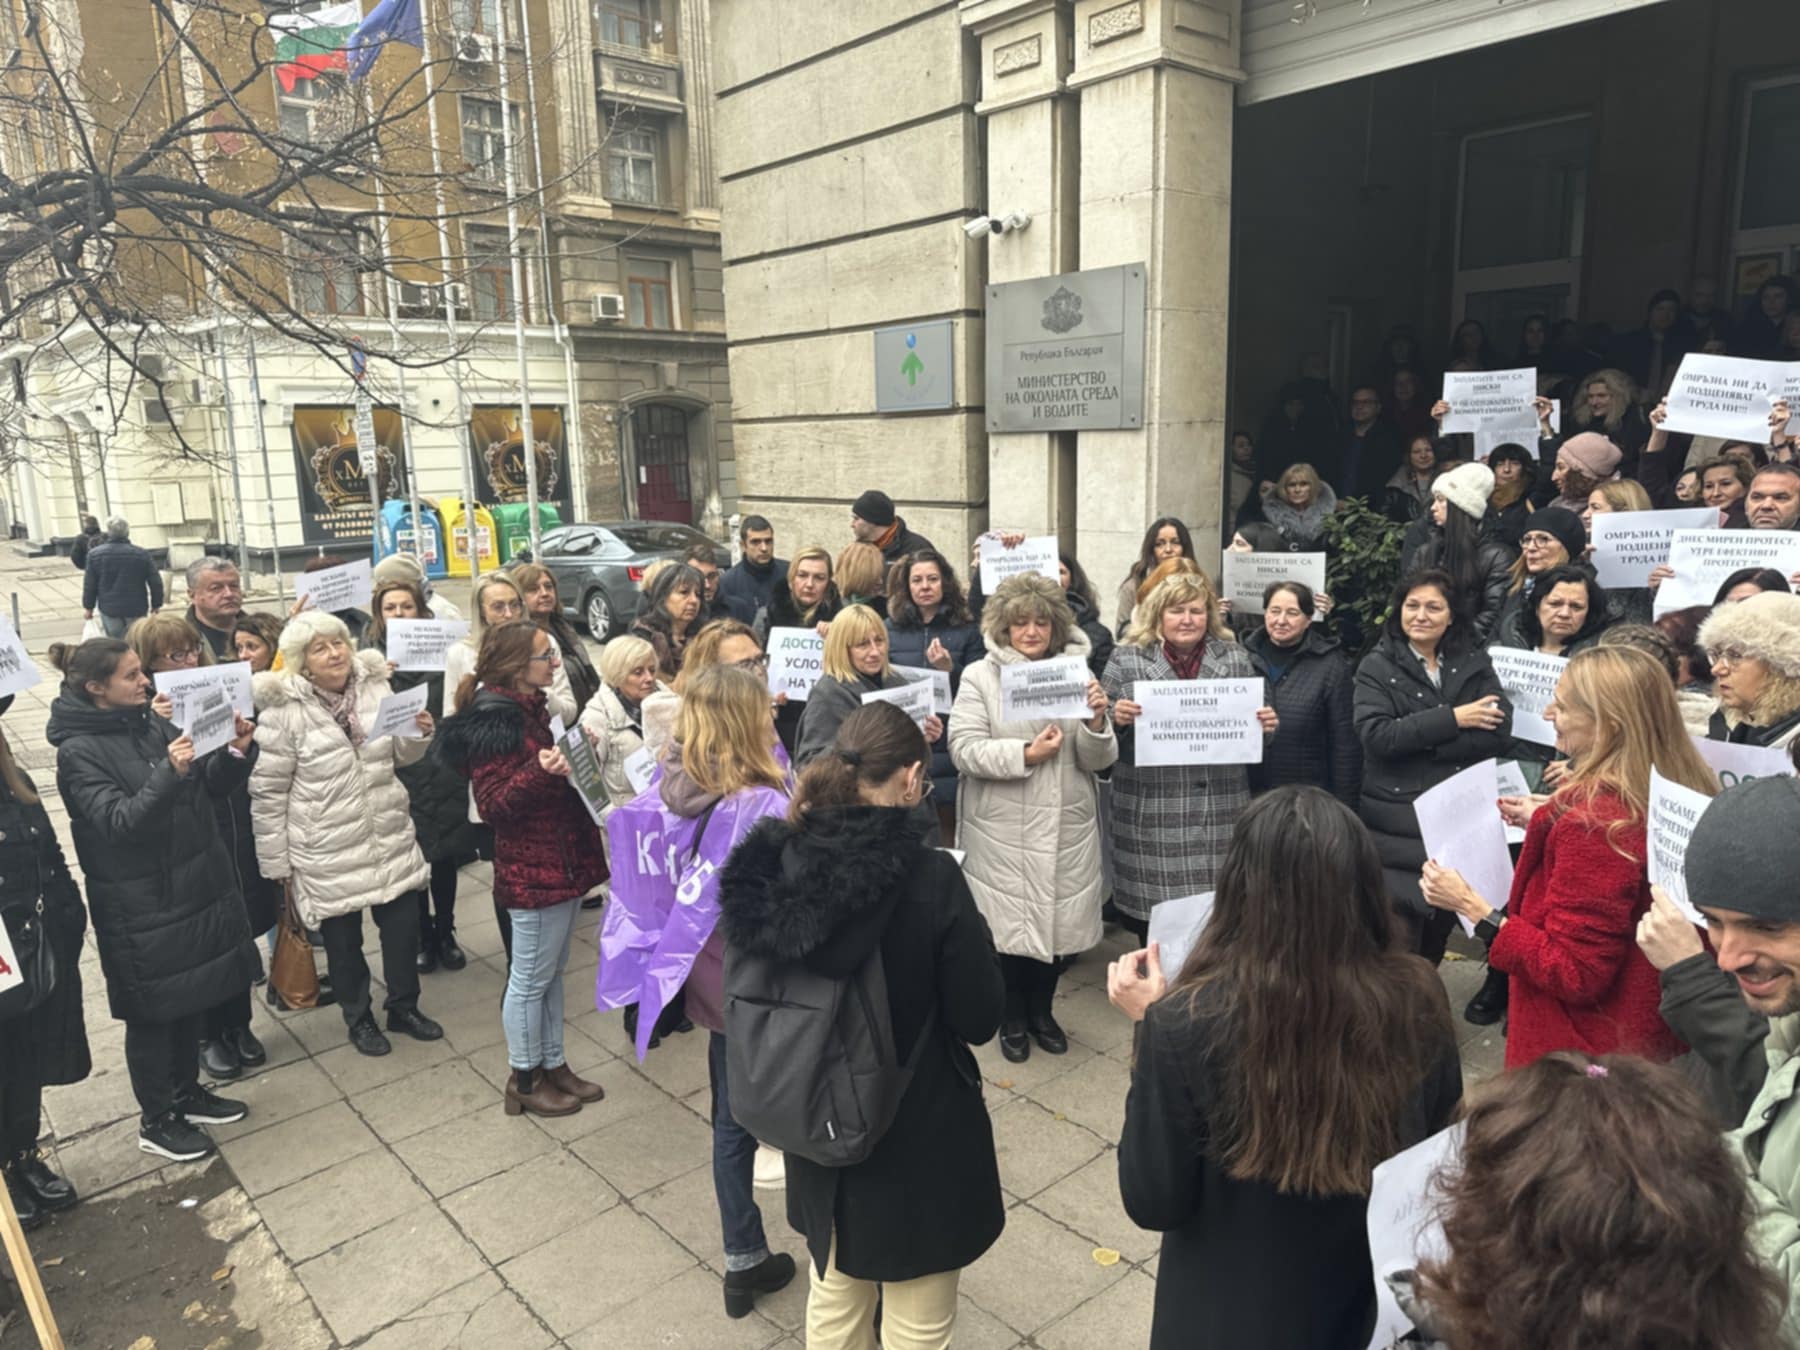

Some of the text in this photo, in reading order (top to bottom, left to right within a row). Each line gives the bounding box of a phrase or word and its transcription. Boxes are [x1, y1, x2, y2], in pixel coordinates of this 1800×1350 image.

[1017, 370, 1106, 389] МИНИСТЕРСТВО
[1682, 373, 1767, 391] ОМРЪЗНА НИ ДА
[1005, 385, 1119, 404] НА ОКОЛНАТА СРЕДА
[1687, 386, 1754, 401] ПОДЦЕНЯВАТ
[1033, 403, 1089, 418] И ВОДИТЕ
[1689, 400, 1720, 411] ТРУДА
[1604, 528, 1674, 541] ОМРЪЗНА Н
[1677, 535, 1705, 544] ДНЕС
[1706, 535, 1743, 545] МИРЕН
[1616, 542, 1672, 553] ПОДЦЕНЯ
[1690, 547, 1779, 557] УТРЕ ЕФЕКТИВЕН
[1620, 554, 1656, 564] ТРУДА
[1703, 559, 1749, 568] ПРОТЕСТ
[1257, 566, 1288, 574] НИСКИ
[780, 636, 824, 650] ДОСТО
[1513, 657, 1551, 670] МИРЕН
[1497, 666, 1559, 685] УТРЕ ЕФЕКТ
[788, 677, 807, 689] НА
[1152, 685, 1248, 696] ЗАПЛАТИТЕ НИ СА
[1180, 697, 1218, 707] НИСКИ
[1150, 719, 1249, 729] И НЕ ОТГОВАРЯТ НА
[1152, 731, 1246, 742] КОМПЕТЕНЦИИТЕ
